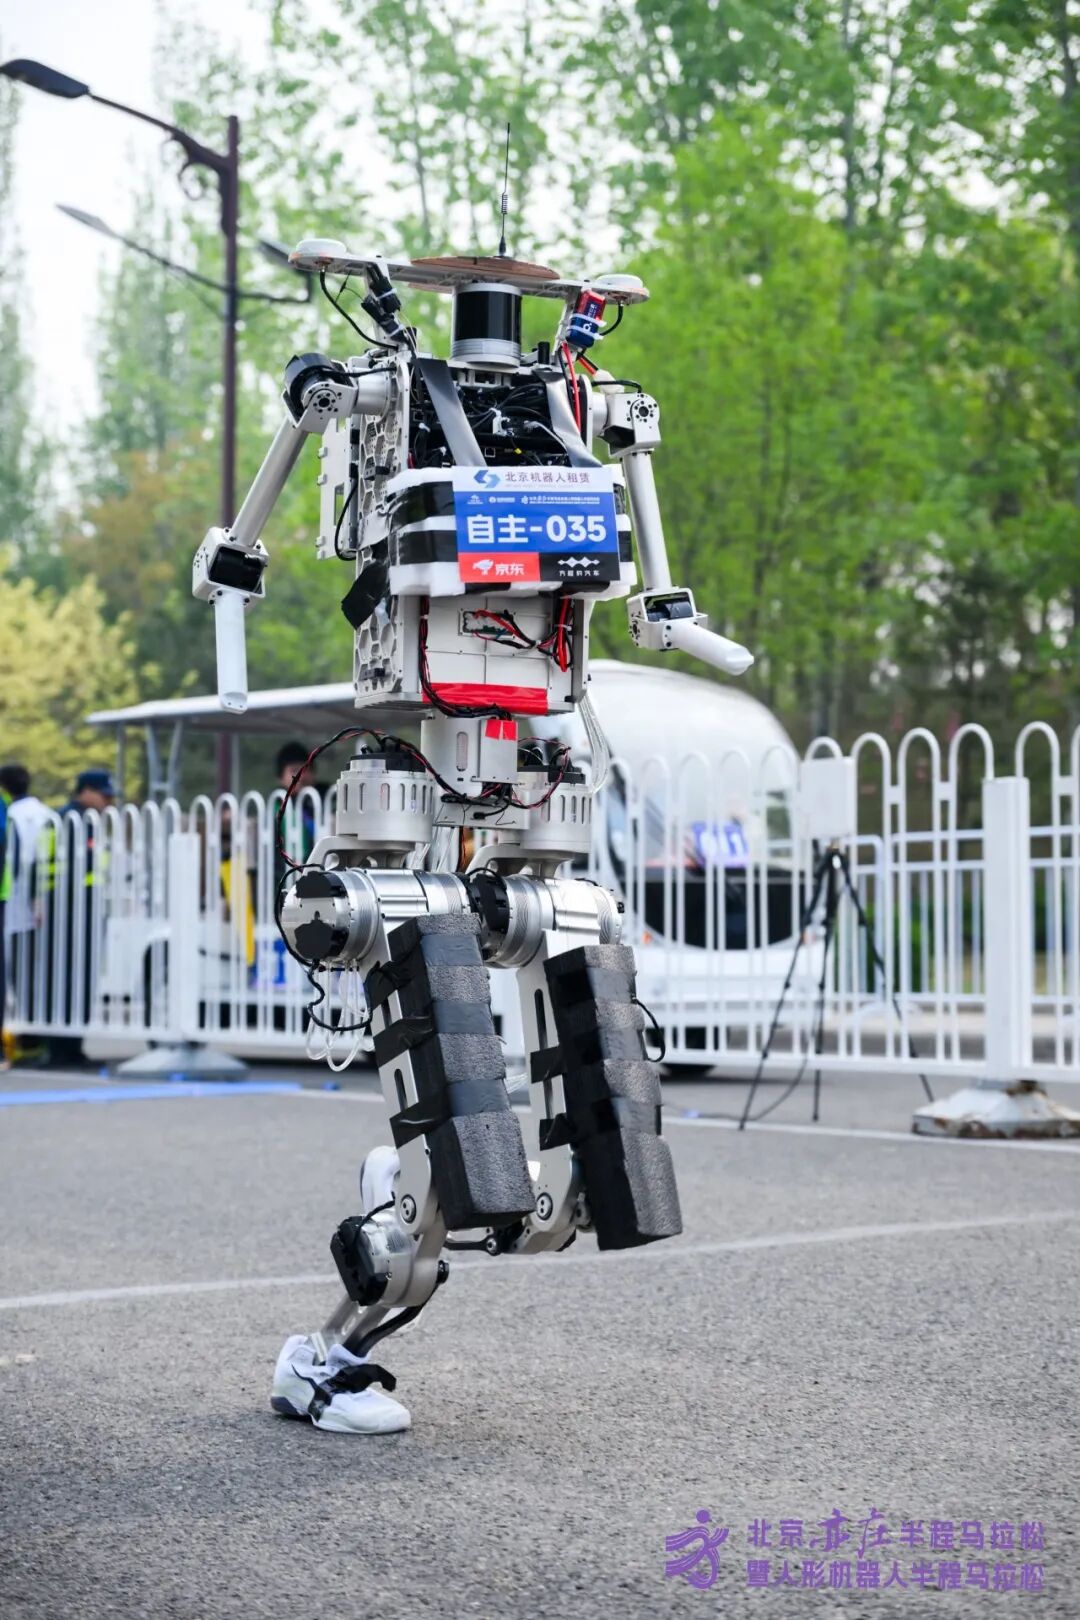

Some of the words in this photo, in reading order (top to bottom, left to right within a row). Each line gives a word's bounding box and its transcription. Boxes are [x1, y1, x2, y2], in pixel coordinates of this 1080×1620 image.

[504, 471, 591, 484] 北京机器人租赁
[467, 514, 607, 544] 自主-035
[495, 563, 525, 576] 京东
